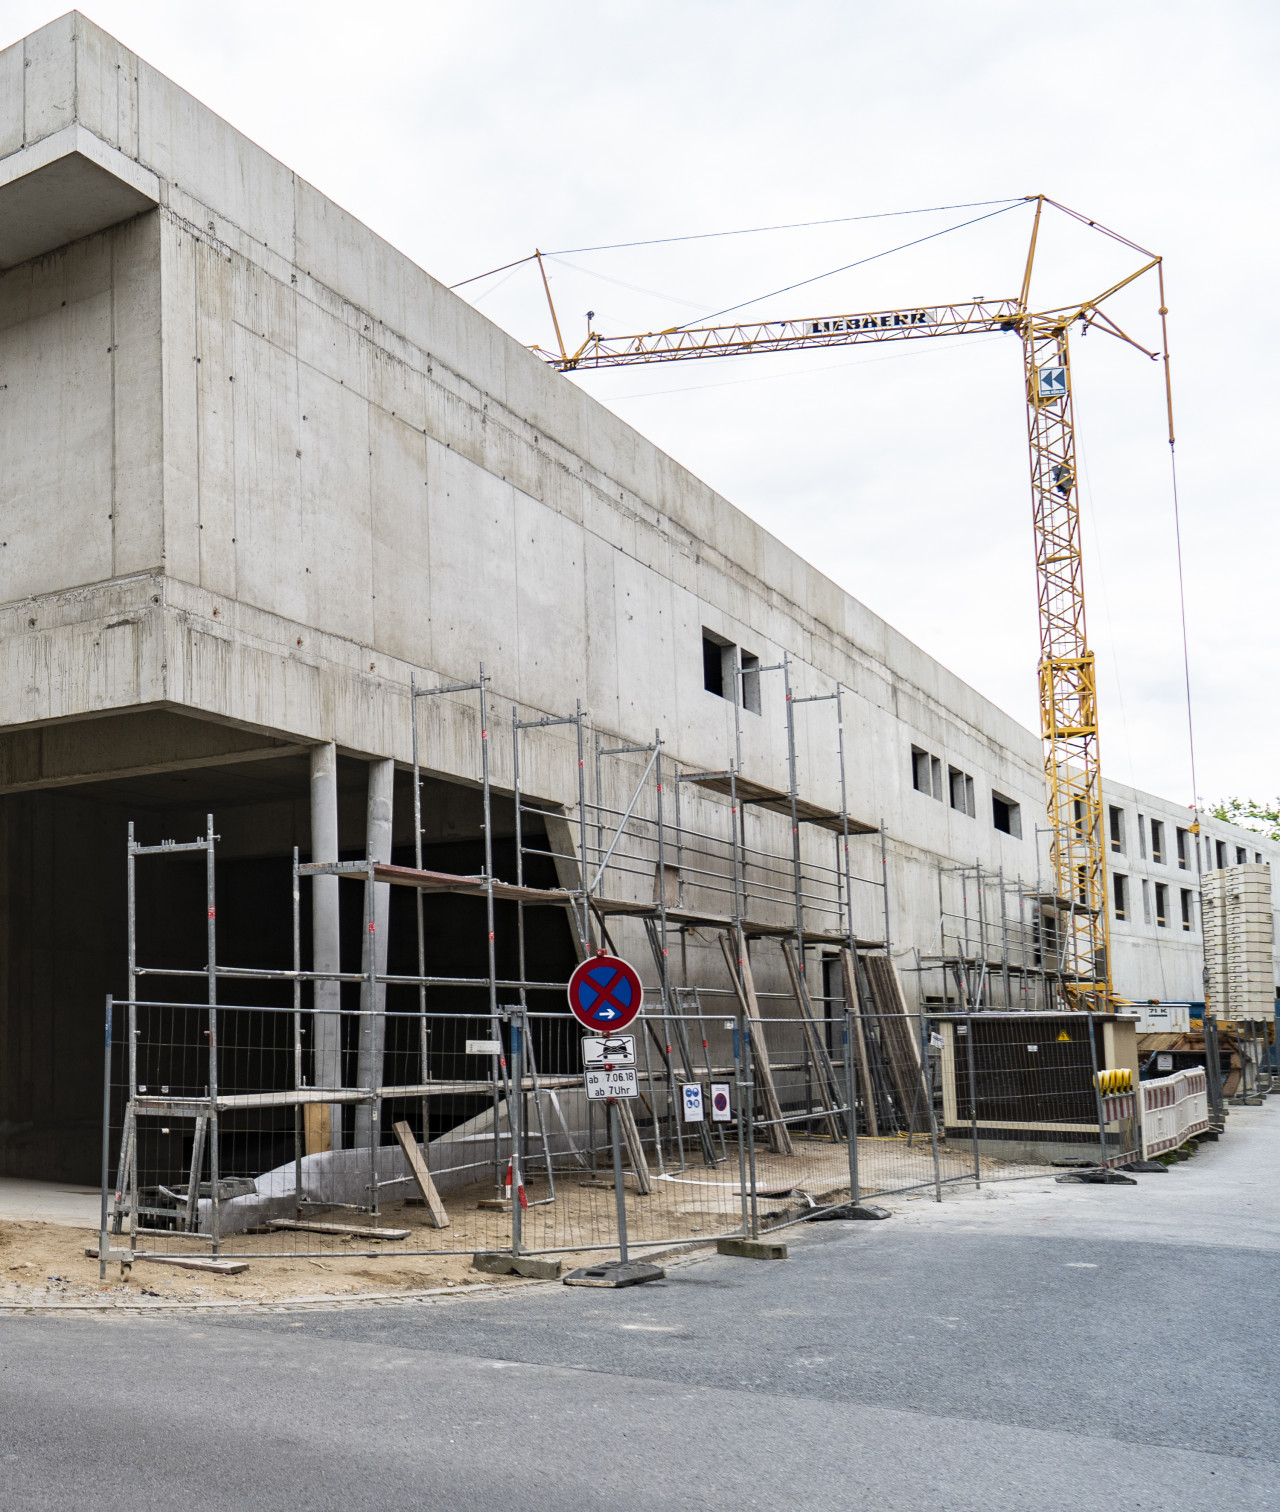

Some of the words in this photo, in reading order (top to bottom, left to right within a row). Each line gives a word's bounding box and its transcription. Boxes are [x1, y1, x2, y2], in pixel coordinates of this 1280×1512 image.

[812, 312, 926, 333] LIEBHERR
[588, 1074, 599, 1084] ab
[605, 1072, 634, 1083] 7.06.18
[594, 1087, 605, 1097] ab
